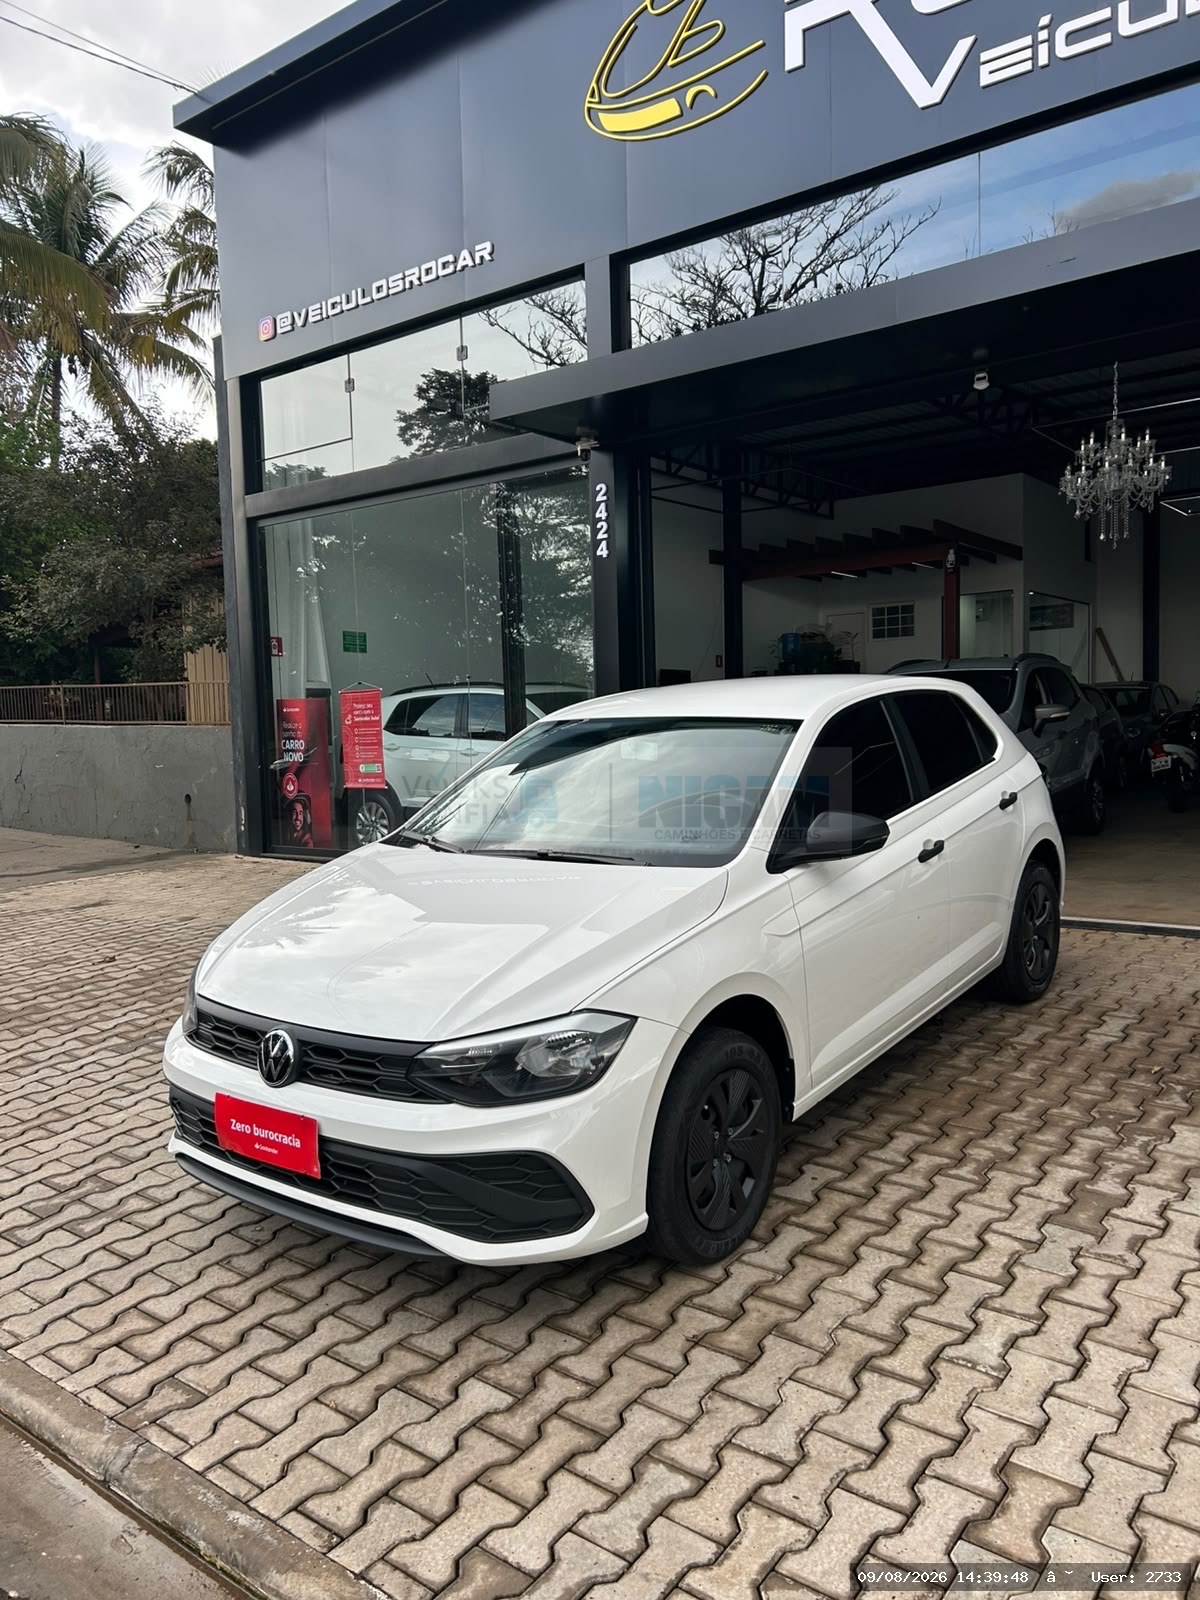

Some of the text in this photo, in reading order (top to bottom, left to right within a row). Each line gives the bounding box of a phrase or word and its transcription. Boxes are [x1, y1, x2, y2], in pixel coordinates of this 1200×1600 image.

[275, 240, 495, 334] @VEICULOSROCAR
[595, 483, 609, 558] 2424
[281, 739, 305, 750] CARRO
[283, 751, 304, 763] NOVO
[230, 1118, 301, 1149] Zero burocracia
